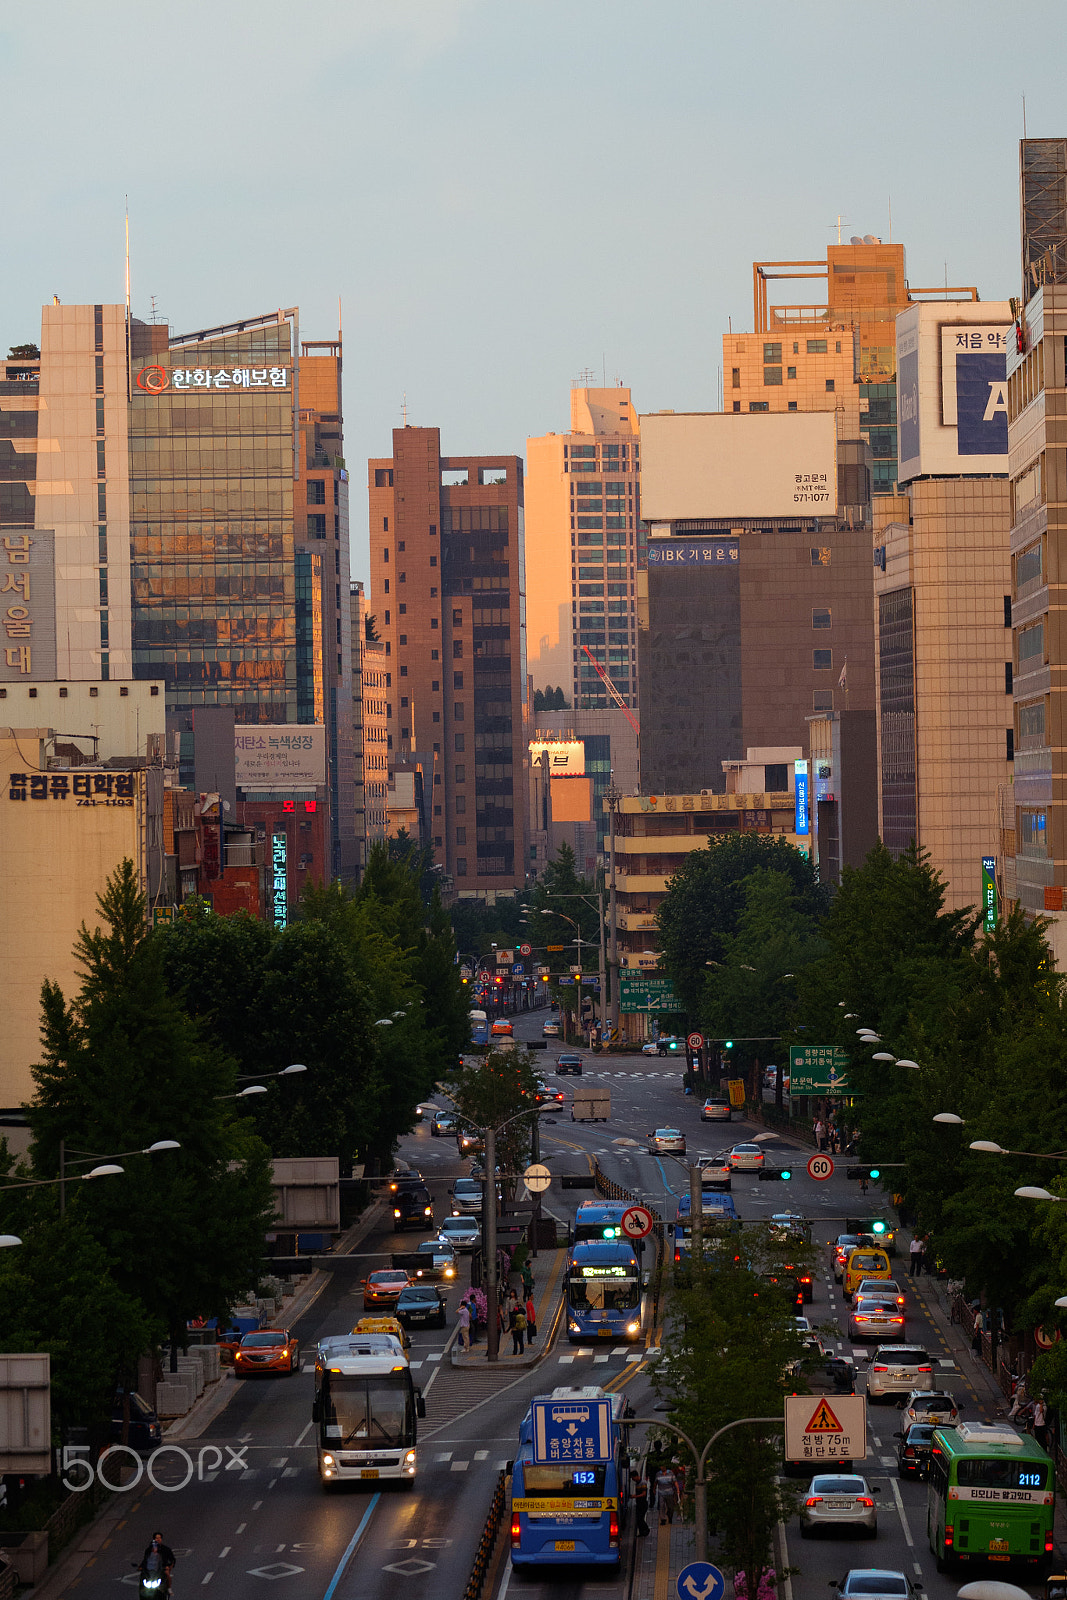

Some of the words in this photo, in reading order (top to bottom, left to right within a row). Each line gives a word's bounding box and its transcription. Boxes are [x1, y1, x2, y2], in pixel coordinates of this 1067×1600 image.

[956, 333, 983, 349] 처음
[172, 367, 287, 389] 한화손해보험
[795, 474, 827, 483] 광고문의
[794, 493, 830, 502] 571-1077
[661, 549, 685, 561] IBK
[689, 549, 738, 560] 기업은행
[234, 736, 266, 750] 저탄소
[268, 735, 314, 750] 녹색성장
[76, 799, 133, 807] 741-1193
[691, 1037, 700, 1046] 60
[804, 1048, 833, 1057] 청량리역
[804, 1057, 833, 1066] 제기동역
[791, 1077, 813, 1086] 보문역
[813, 1161, 828, 1174] 60
[574, 1310, 585, 1318] 152
[549, 1437, 595, 1449] 중앙차로
[801, 1434, 824, 1446] 전방
[827, 1434, 850, 1445] 75m
[551, 1448, 596, 1460] 버스전용
[803, 1446, 850, 1457] 횡단보도
[573, 1471, 595, 1484] 152
[1018, 1473, 1041, 1486] 2112
